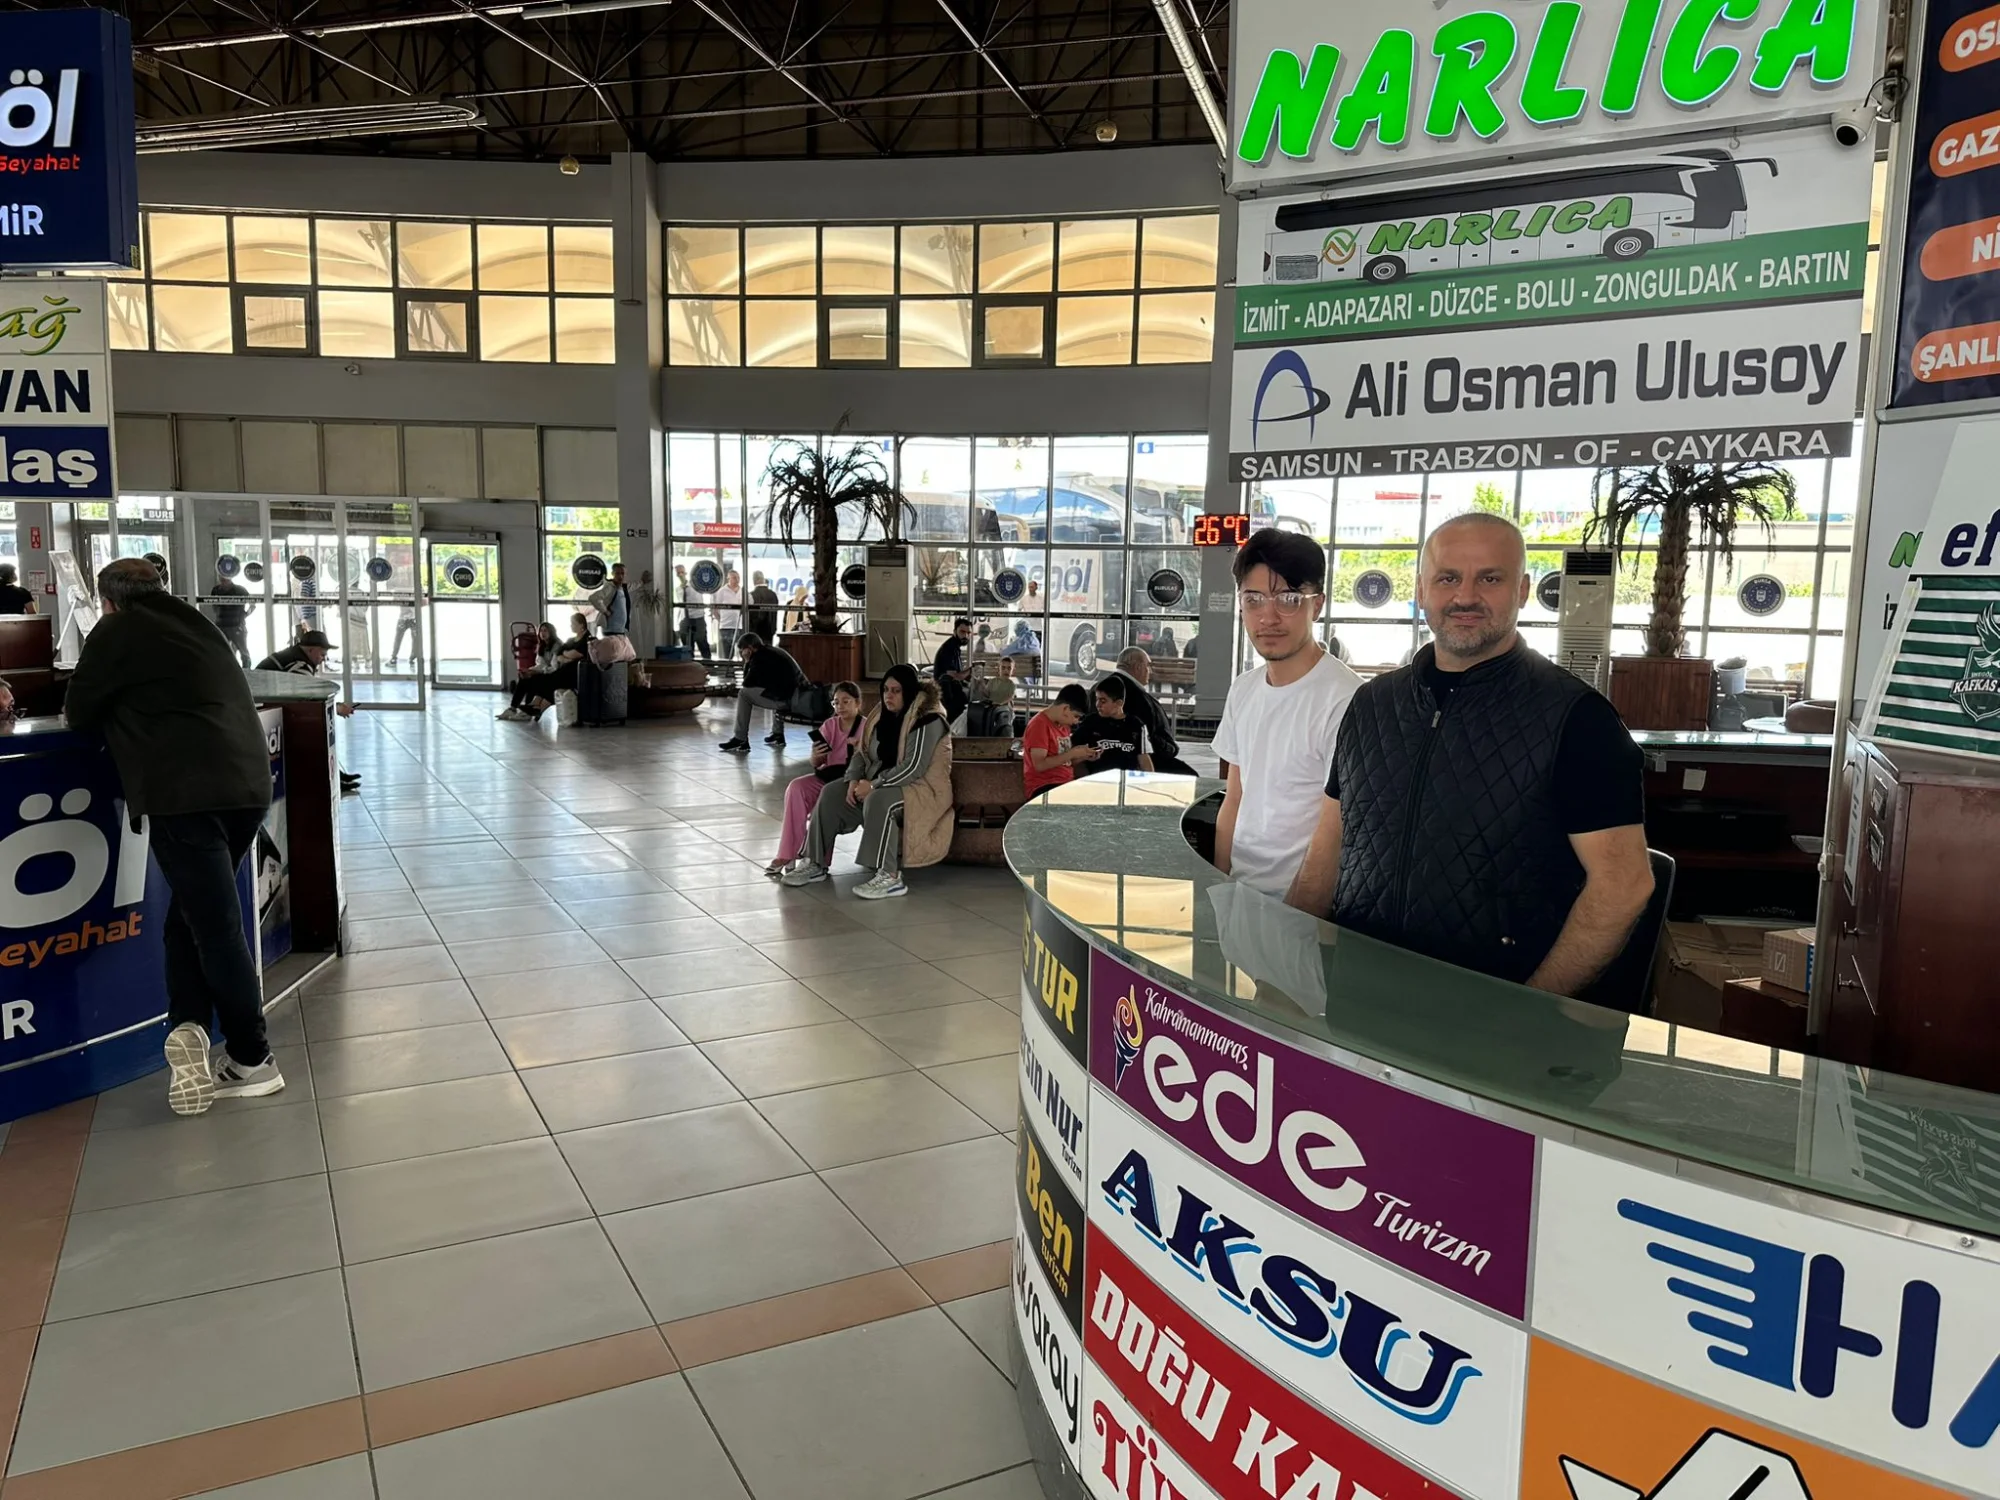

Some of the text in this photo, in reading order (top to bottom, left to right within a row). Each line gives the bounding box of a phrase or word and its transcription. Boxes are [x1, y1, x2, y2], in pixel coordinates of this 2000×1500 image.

[1955, 19, 2000, 58] OS
[1237, 0, 1856, 163] NARLICA
[1366, 196, 1633, 255] NARLICA
[1243, 299, 1290, 333] İZMİT
[1304, 293, 1412, 329] ADAPAZARI
[1430, 283, 1498, 318] DÜZCE
[1517, 277, 1575, 311] BOLU
[1593, 261, 1738, 304] ZONGULDAK
[1759, 250, 1850, 289] BARTIN
[1345, 339, 1847, 419] Ali Osman Ulusoy
[1241, 452, 1362, 479] SAMSUN
[1391, 443, 1542, 472] TRABZON
[1574, 439, 1619, 465] OF
[1652, 429, 1831, 466] ÇAYKARA
[1952, 678, 1999, 694] KAFKAS
[1033, 930, 1078, 1035] TUR
[1145, 987, 1249, 1071] Kahramanmaraş
[1046, 1069, 1083, 1156] Nur
[1143, 1035, 1367, 1212] ede
[1026, 1131, 1073, 1277] Ben
[1061, 1143, 1082, 1182] Turizm
[1041, 1237, 1068, 1298] turizm
[1374, 1191, 1492, 1276] Turizm
[1101, 1149, 1482, 1425] AKSU
[1090, 1269, 1385, 1500] DOĞU KA
